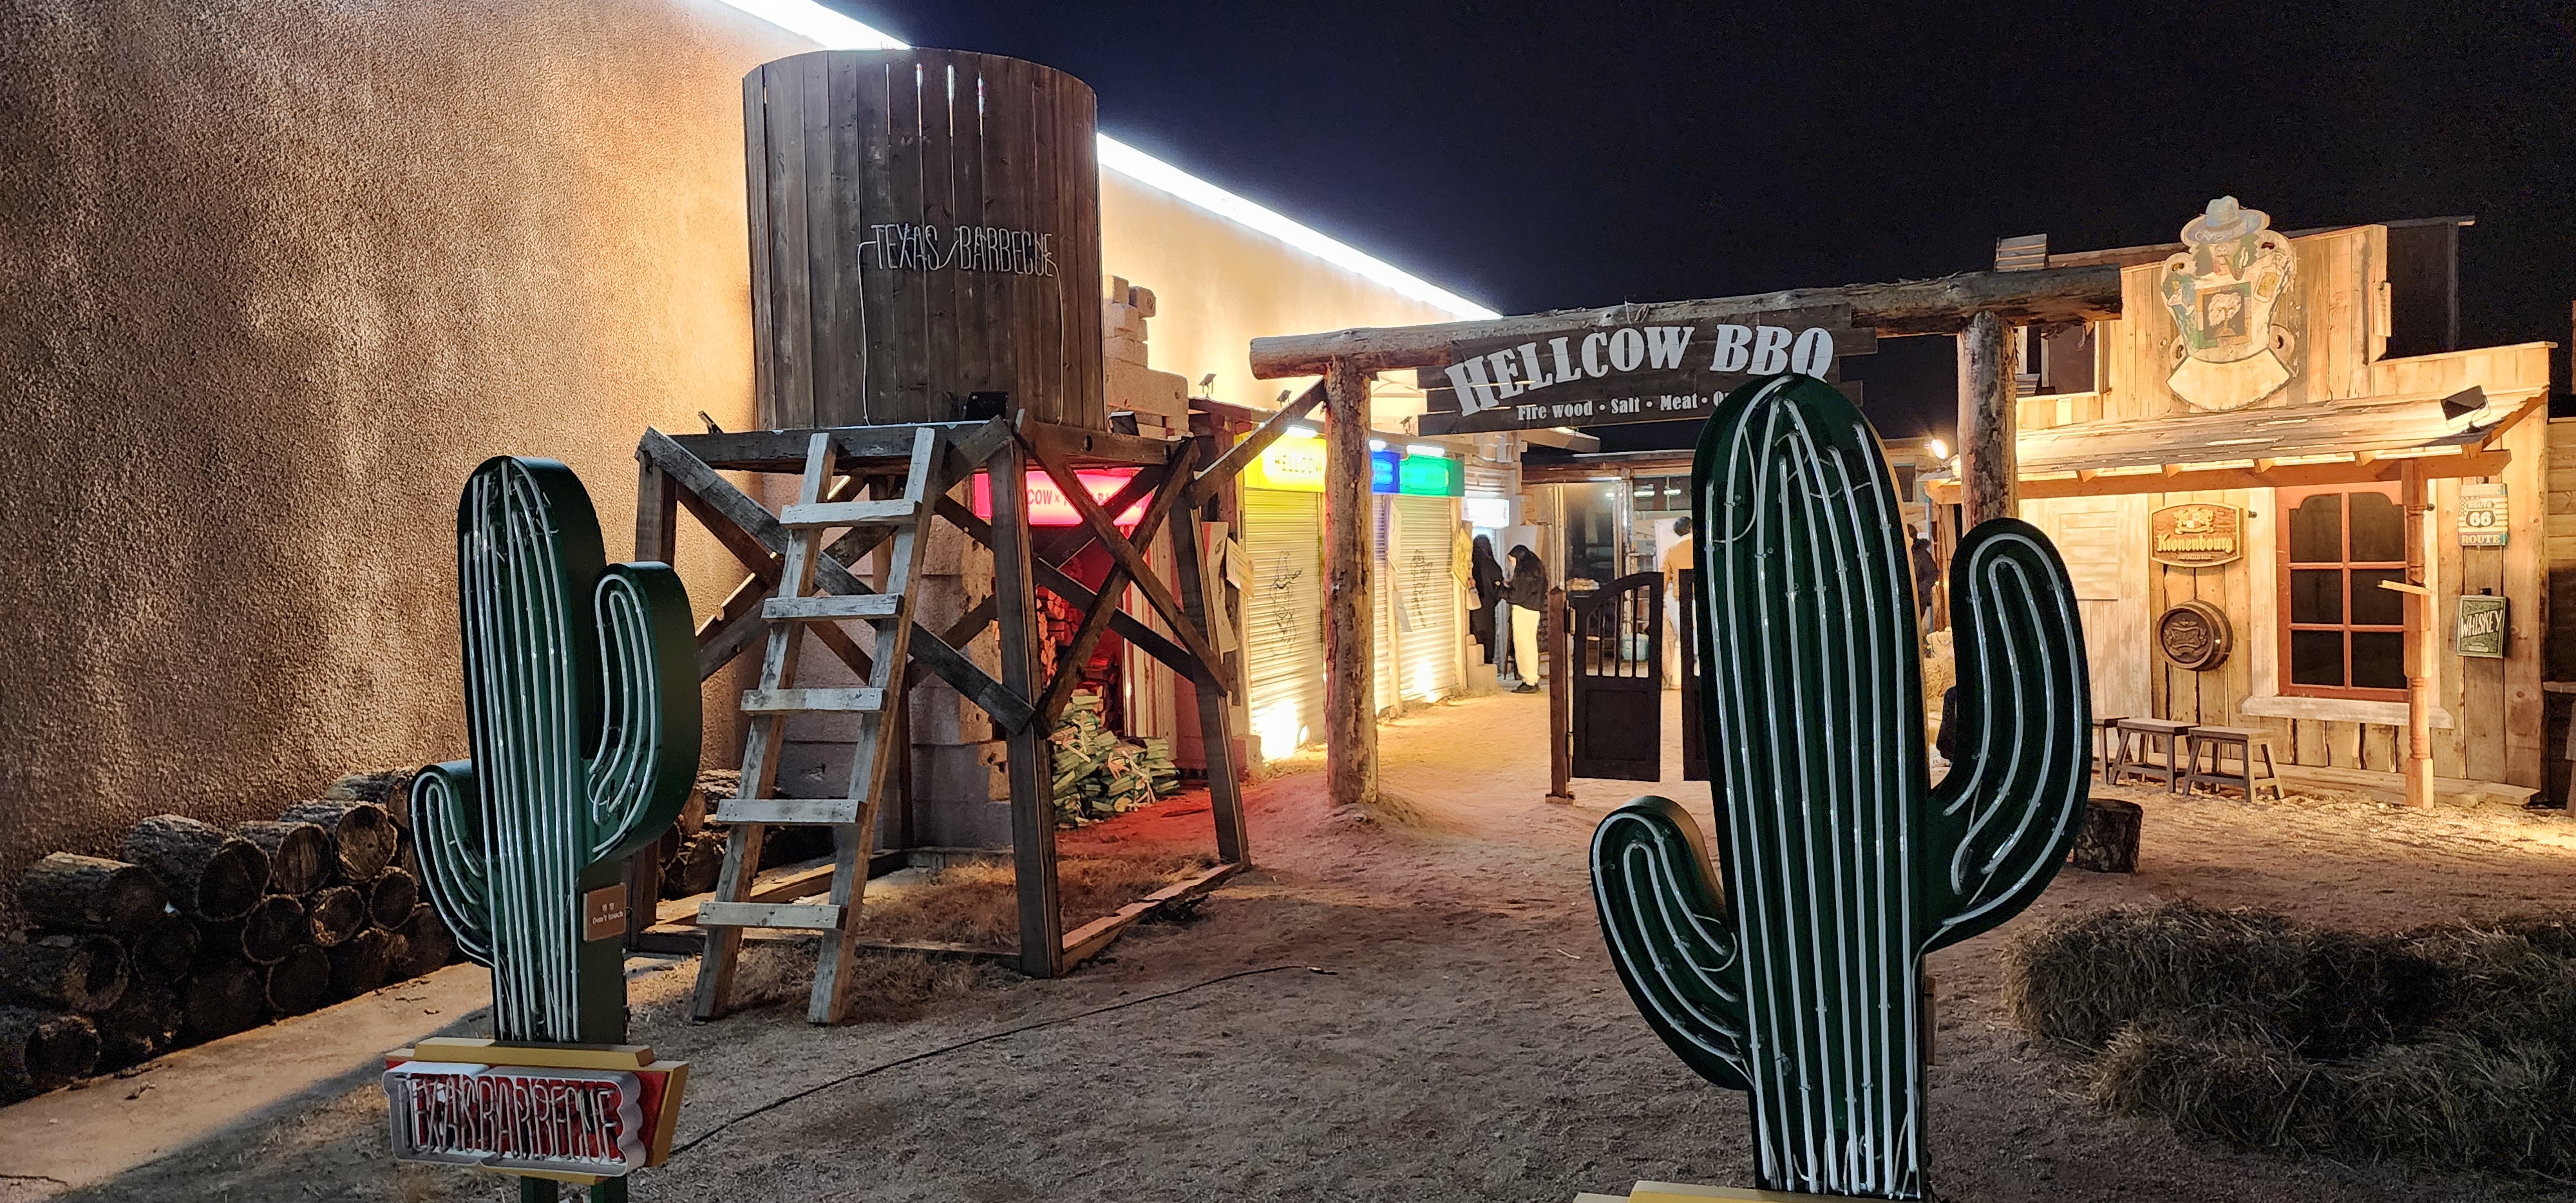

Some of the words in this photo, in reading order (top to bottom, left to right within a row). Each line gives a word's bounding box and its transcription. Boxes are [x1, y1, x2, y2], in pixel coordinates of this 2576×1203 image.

[870, 223, 940, 270] TEXAS
[956, 225, 1054, 277] BARBECUE
[1444, 327, 1696, 417] HELLCOW
[1709, 324, 1834, 383] BBQ
[1517, 405, 1547, 421] Fire
[1552, 401, 1593, 418] wood
[1611, 397, 1640, 414] Salt
[1660, 393, 1698, 411] Meat
[2469, 511, 2492, 526] 66
[2156, 533, 2233, 554] Kronenbourg
[2461, 535, 2500, 544] ROUTE
[2461, 609, 2503, 638] WHISKEY
